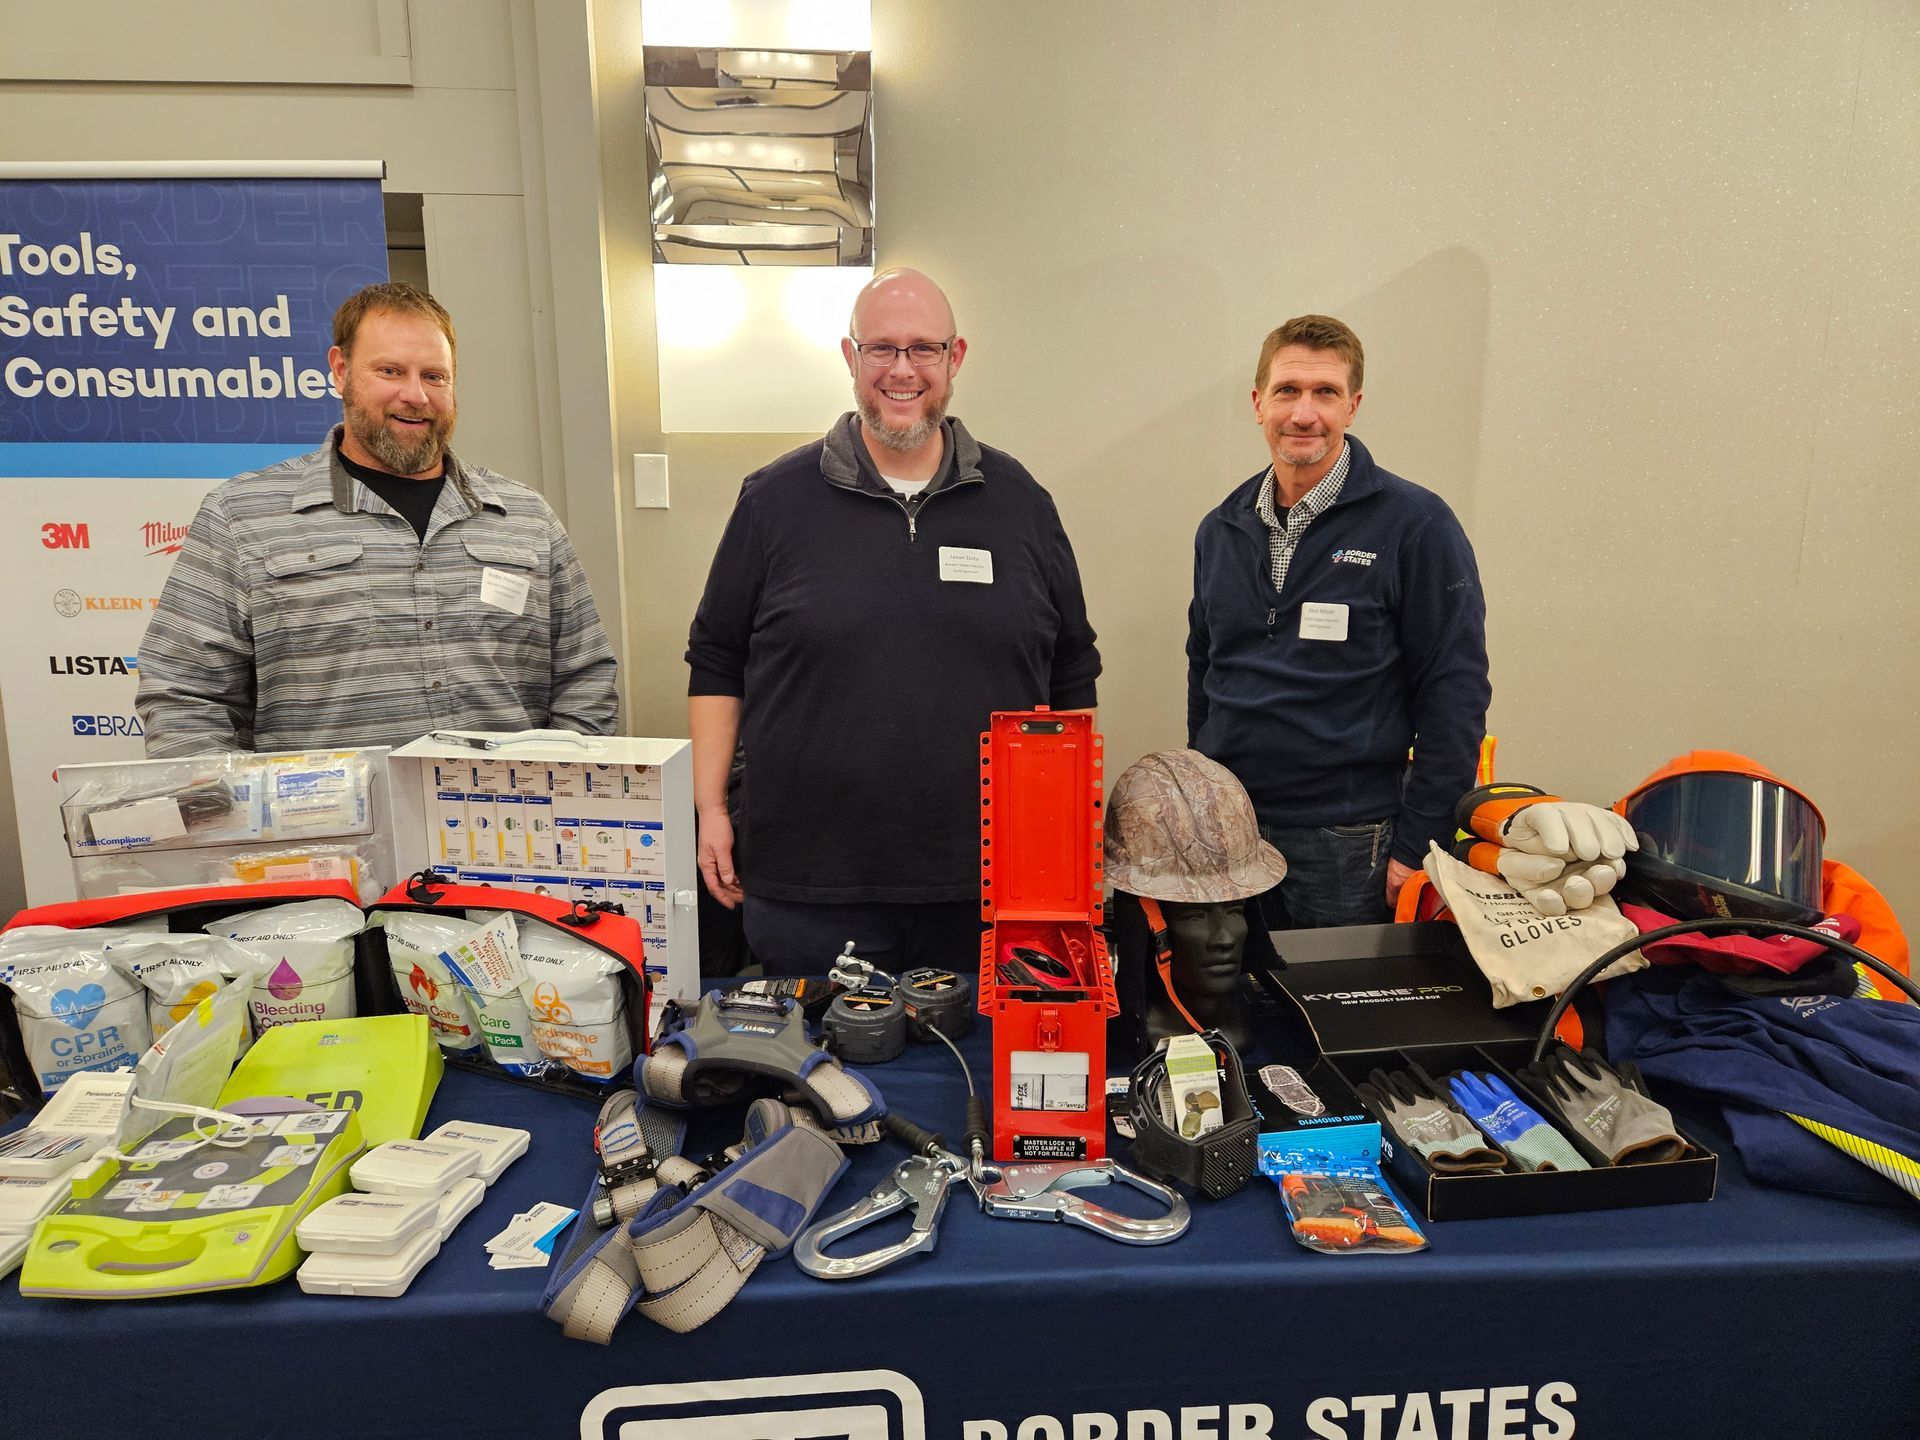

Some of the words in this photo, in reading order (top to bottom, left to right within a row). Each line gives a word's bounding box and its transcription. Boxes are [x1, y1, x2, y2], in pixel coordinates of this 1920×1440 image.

[0, 231, 136, 281] Tools,
[0, 293, 176, 350] Safety
[192, 294, 292, 338] and
[41, 522, 90, 549] 3M
[1342, 555, 1372, 567] STATES
[1344, 549, 1377, 560] BORDER
[84, 597, 144, 610] KLEIN
[49, 655, 129, 675] LISTA
[76, 835, 152, 848] SmartCompliance
[1500, 915, 1582, 949] GLOVES
[468, 939, 485, 960] First
[483, 960, 495, 976] Aid
[492, 976, 502, 989] Kit
[533, 955, 545, 963] AID
[13, 967, 43, 977] FIRST
[140, 959, 168, 976] FIRST
[1416, 985, 1464, 994] PRO
[254, 1001, 326, 1015] Bleeding
[1359, 997, 1395, 1005] PRODUCT
[429, 1005, 461, 1021] Care
[1801, 1008, 1816, 1019] 40
[1816, 1000, 1841, 1011] CAL
[260, 1015, 322, 1029] Contrl
[479, 1013, 511, 1029] Care
[50, 1025, 120, 1057] CPR
[495, 1035, 517, 1046] Pack
[56, 1058, 73, 1068] or
[72, 1043, 125, 1064] Sprains
[287, 1089, 364, 1113] ED
[1297, 1116, 1343, 1126] DIAMOND
[1343, 1114, 1365, 1123] GRIP
[1304, 1381, 1578, 1440] STATES
